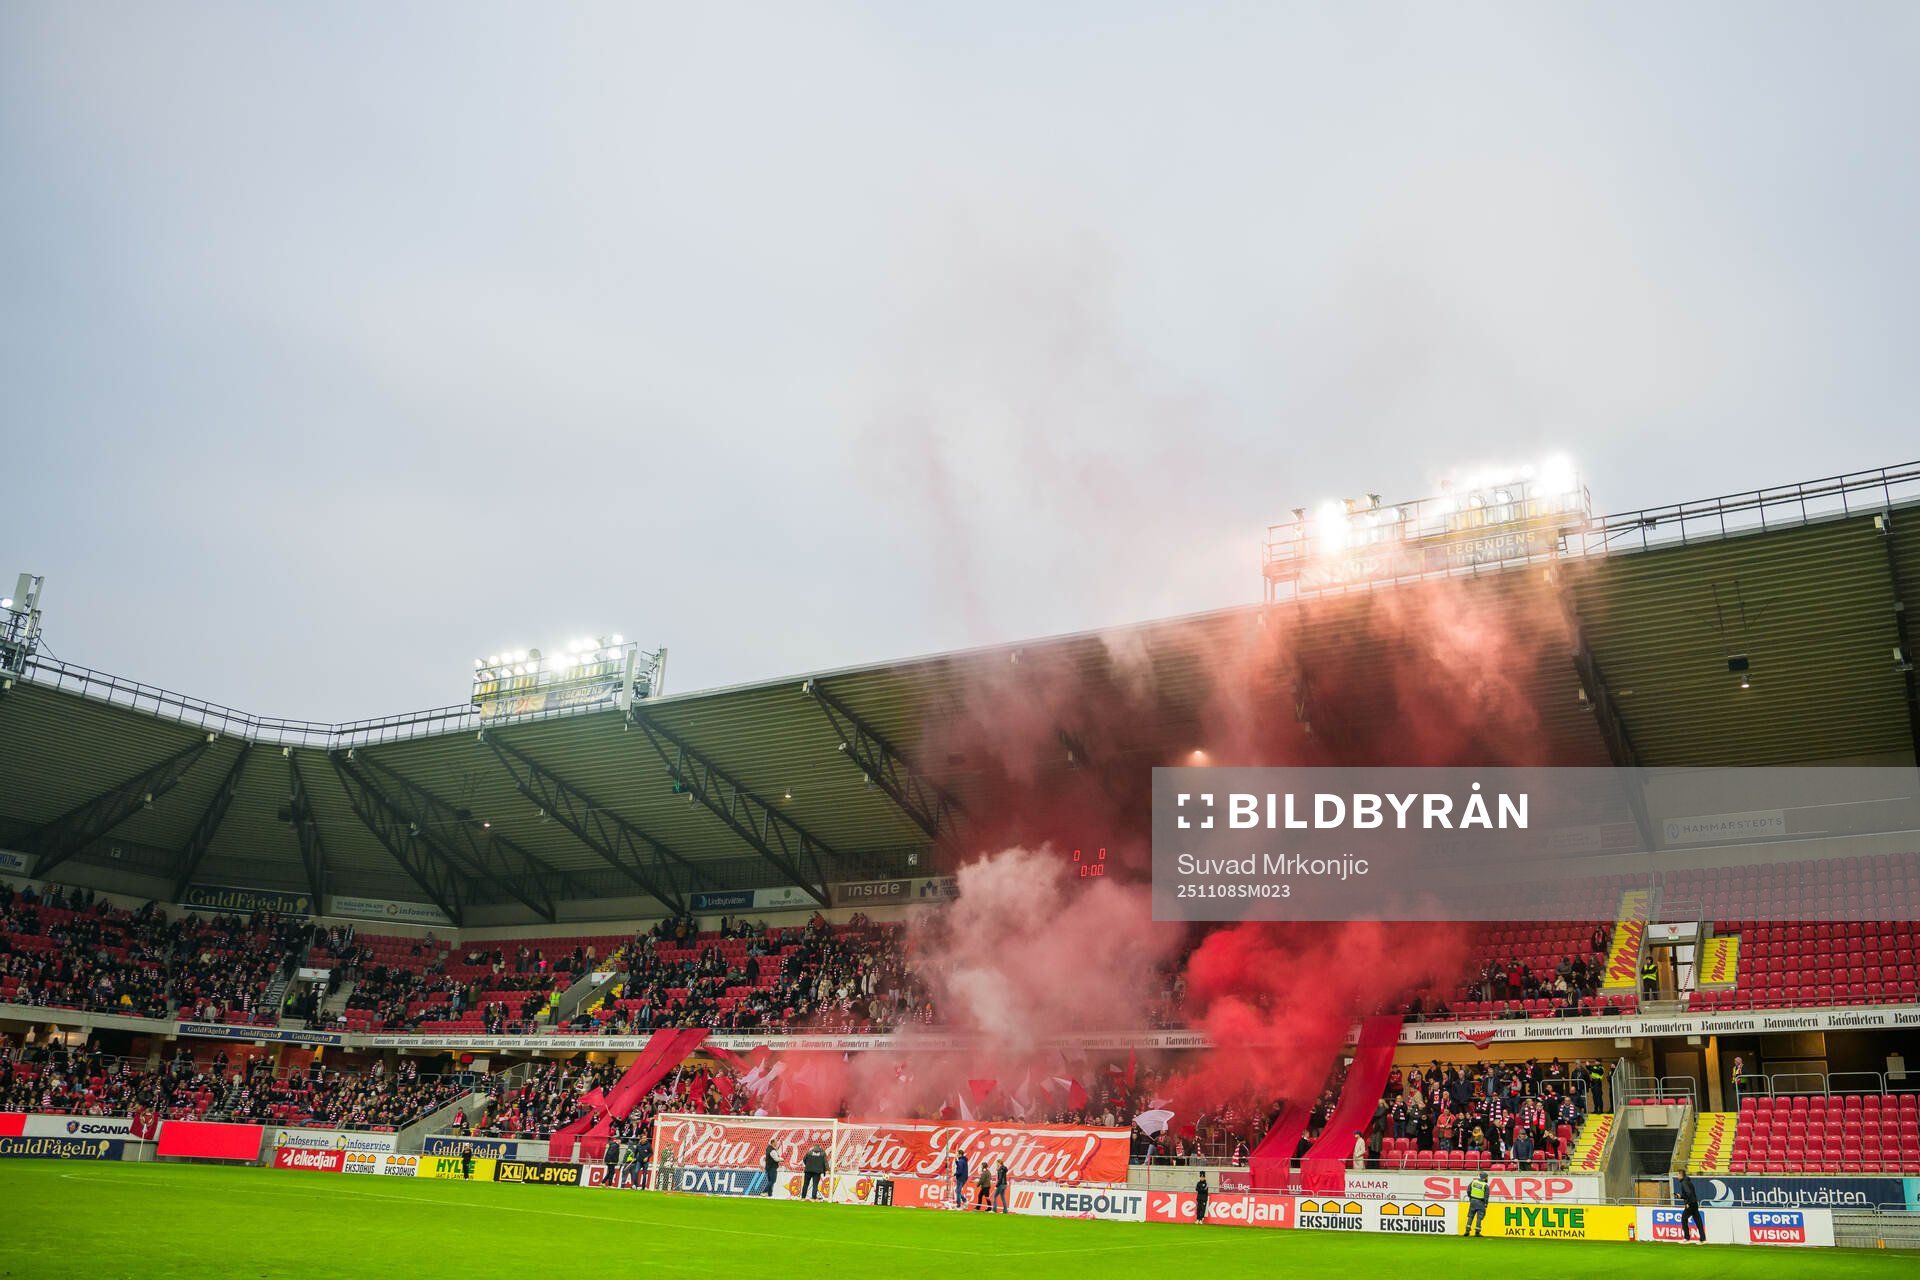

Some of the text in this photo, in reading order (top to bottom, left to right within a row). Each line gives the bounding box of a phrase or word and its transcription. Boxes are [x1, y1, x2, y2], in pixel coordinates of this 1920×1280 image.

[81, 1124, 130, 1135] SCANIA
[0, 1138, 97, 1159] GuldFågeln
[288, 1135, 390, 1151] infoservice infoservice
[293, 1150, 338, 1169] elkedjan
[436, 1158, 476, 1174] HYLE
[525, 1167, 577, 1182] XL-BYGG
[681, 1170, 744, 1192] DAHL
[1348, 1180, 1389, 1190] KALMAR
[1038, 1192, 1142, 1215] TREBOLIT
[1741, 1186, 1867, 1209] Lindbytvätten
[1181, 1196, 1285, 1225] ekedjan
[1504, 1206, 1585, 1228] HYLTE
[1299, 1213, 1446, 1233] EKSJÖHUS EKSJÖHUS
[1752, 1214, 1799, 1226] SPORT
[1505, 1228, 1585, 1239] JAKT & LANTMAN
[1656, 1227, 1701, 1238] VISIN
[1753, 1229, 1800, 1241] VISION
